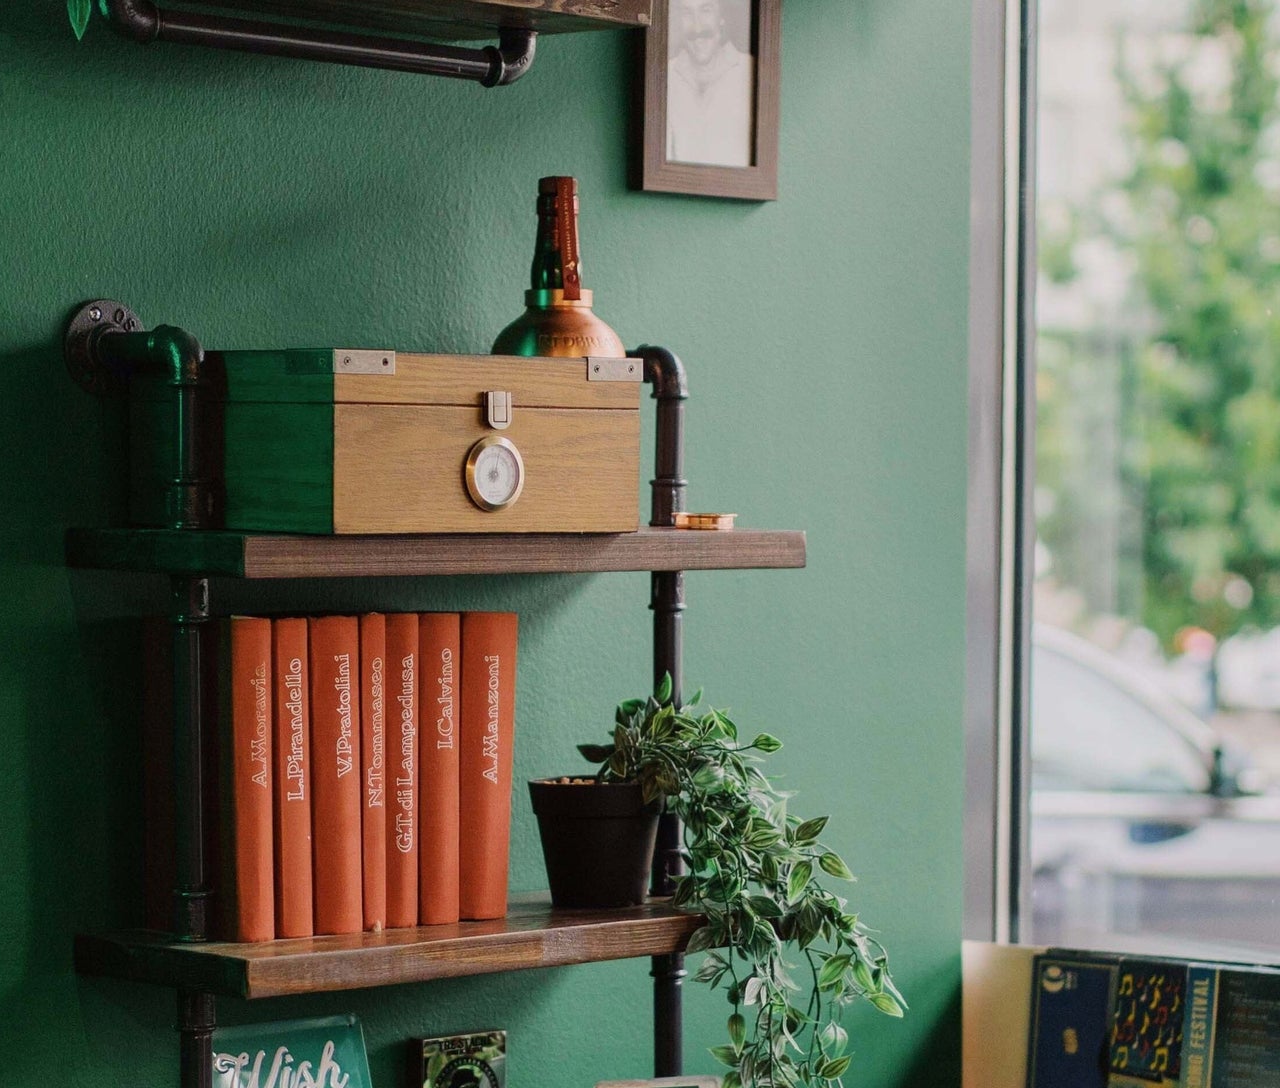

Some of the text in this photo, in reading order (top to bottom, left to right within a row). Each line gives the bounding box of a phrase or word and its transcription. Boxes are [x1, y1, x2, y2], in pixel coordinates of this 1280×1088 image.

[251, 662, 268, 789] A.Moravia
[287, 657, 305, 801] L.Pirandello
[334, 653, 353, 779] V.Pratolini
[368, 656, 383, 808] N.Tommaseo
[396, 653, 414, 787] Lampedusa
[437, 647, 454, 751] I.Calvino
[482, 653, 500, 784] A.Manzoni
[1190, 978, 1210, 1049] FESTIVAL
